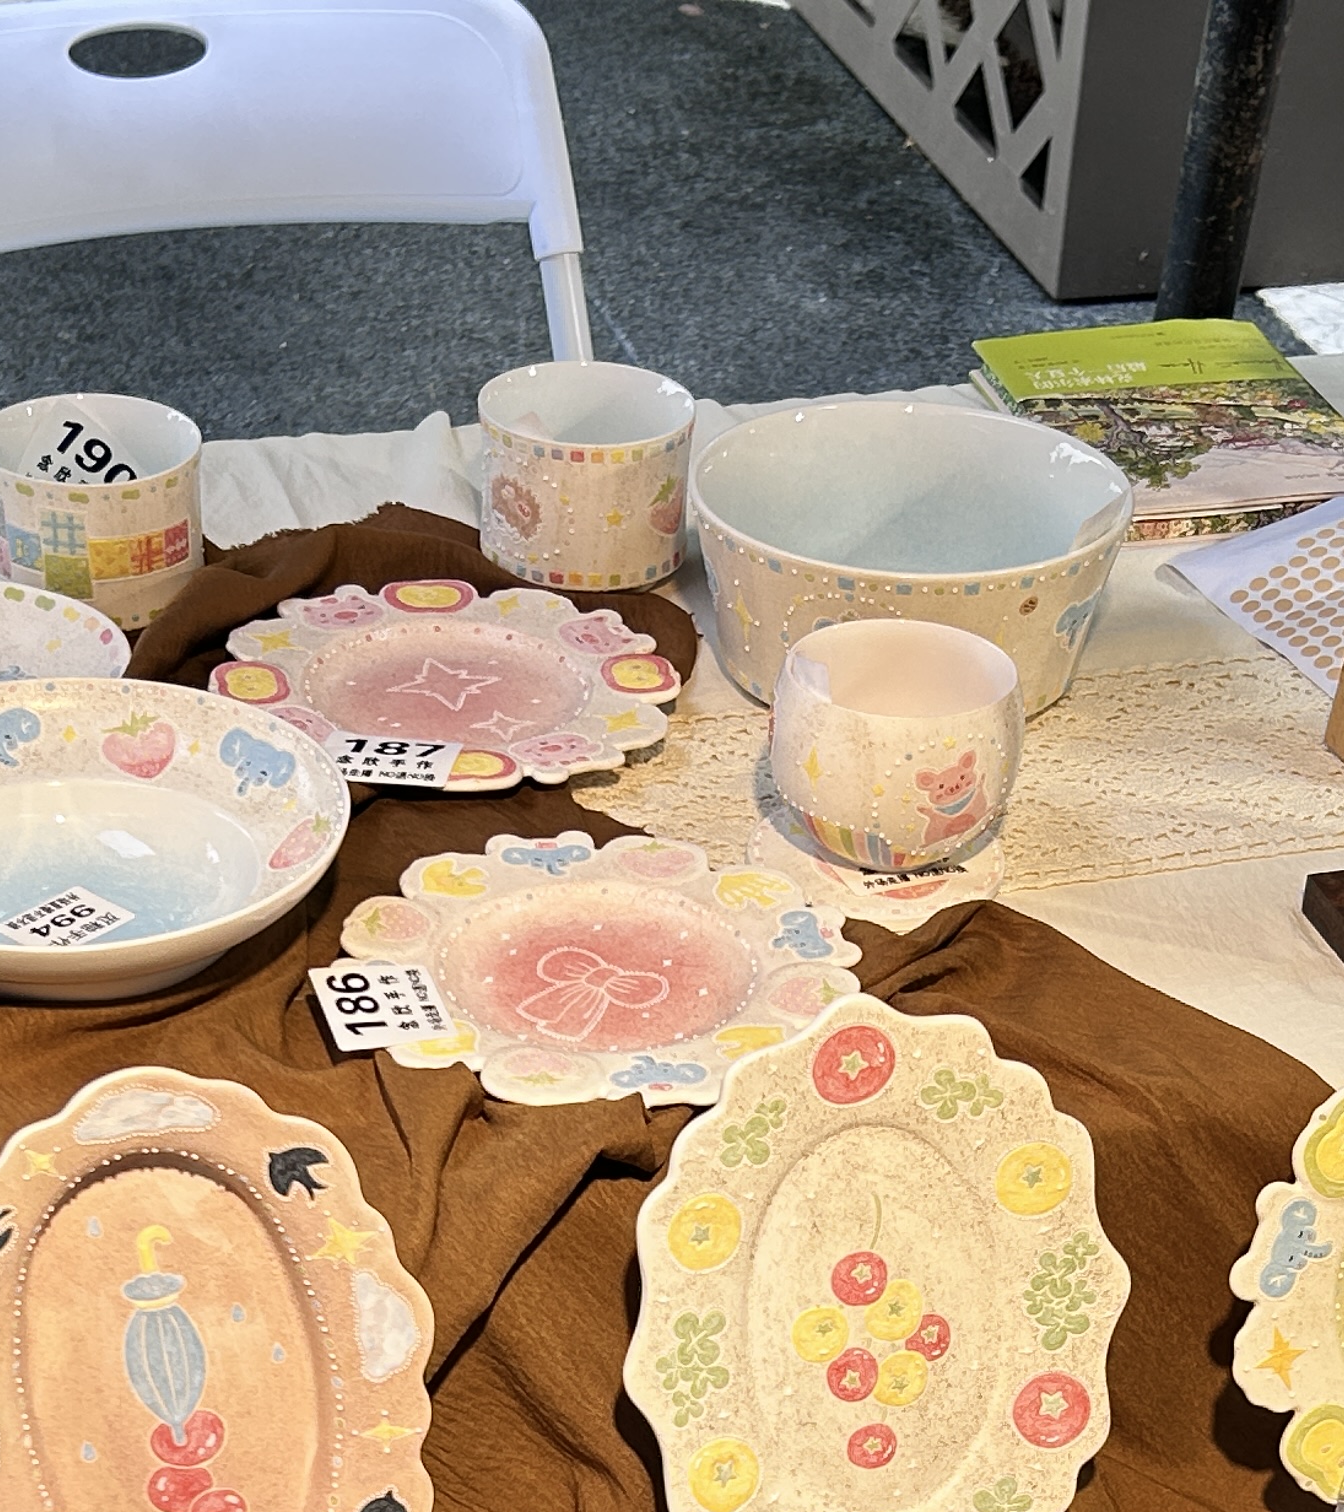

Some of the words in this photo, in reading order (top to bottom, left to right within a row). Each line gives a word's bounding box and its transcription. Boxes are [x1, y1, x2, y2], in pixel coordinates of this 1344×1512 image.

[344, 738, 447, 758] 187
[28, 903, 97, 939] 994
[326, 972, 389, 1037] 186
